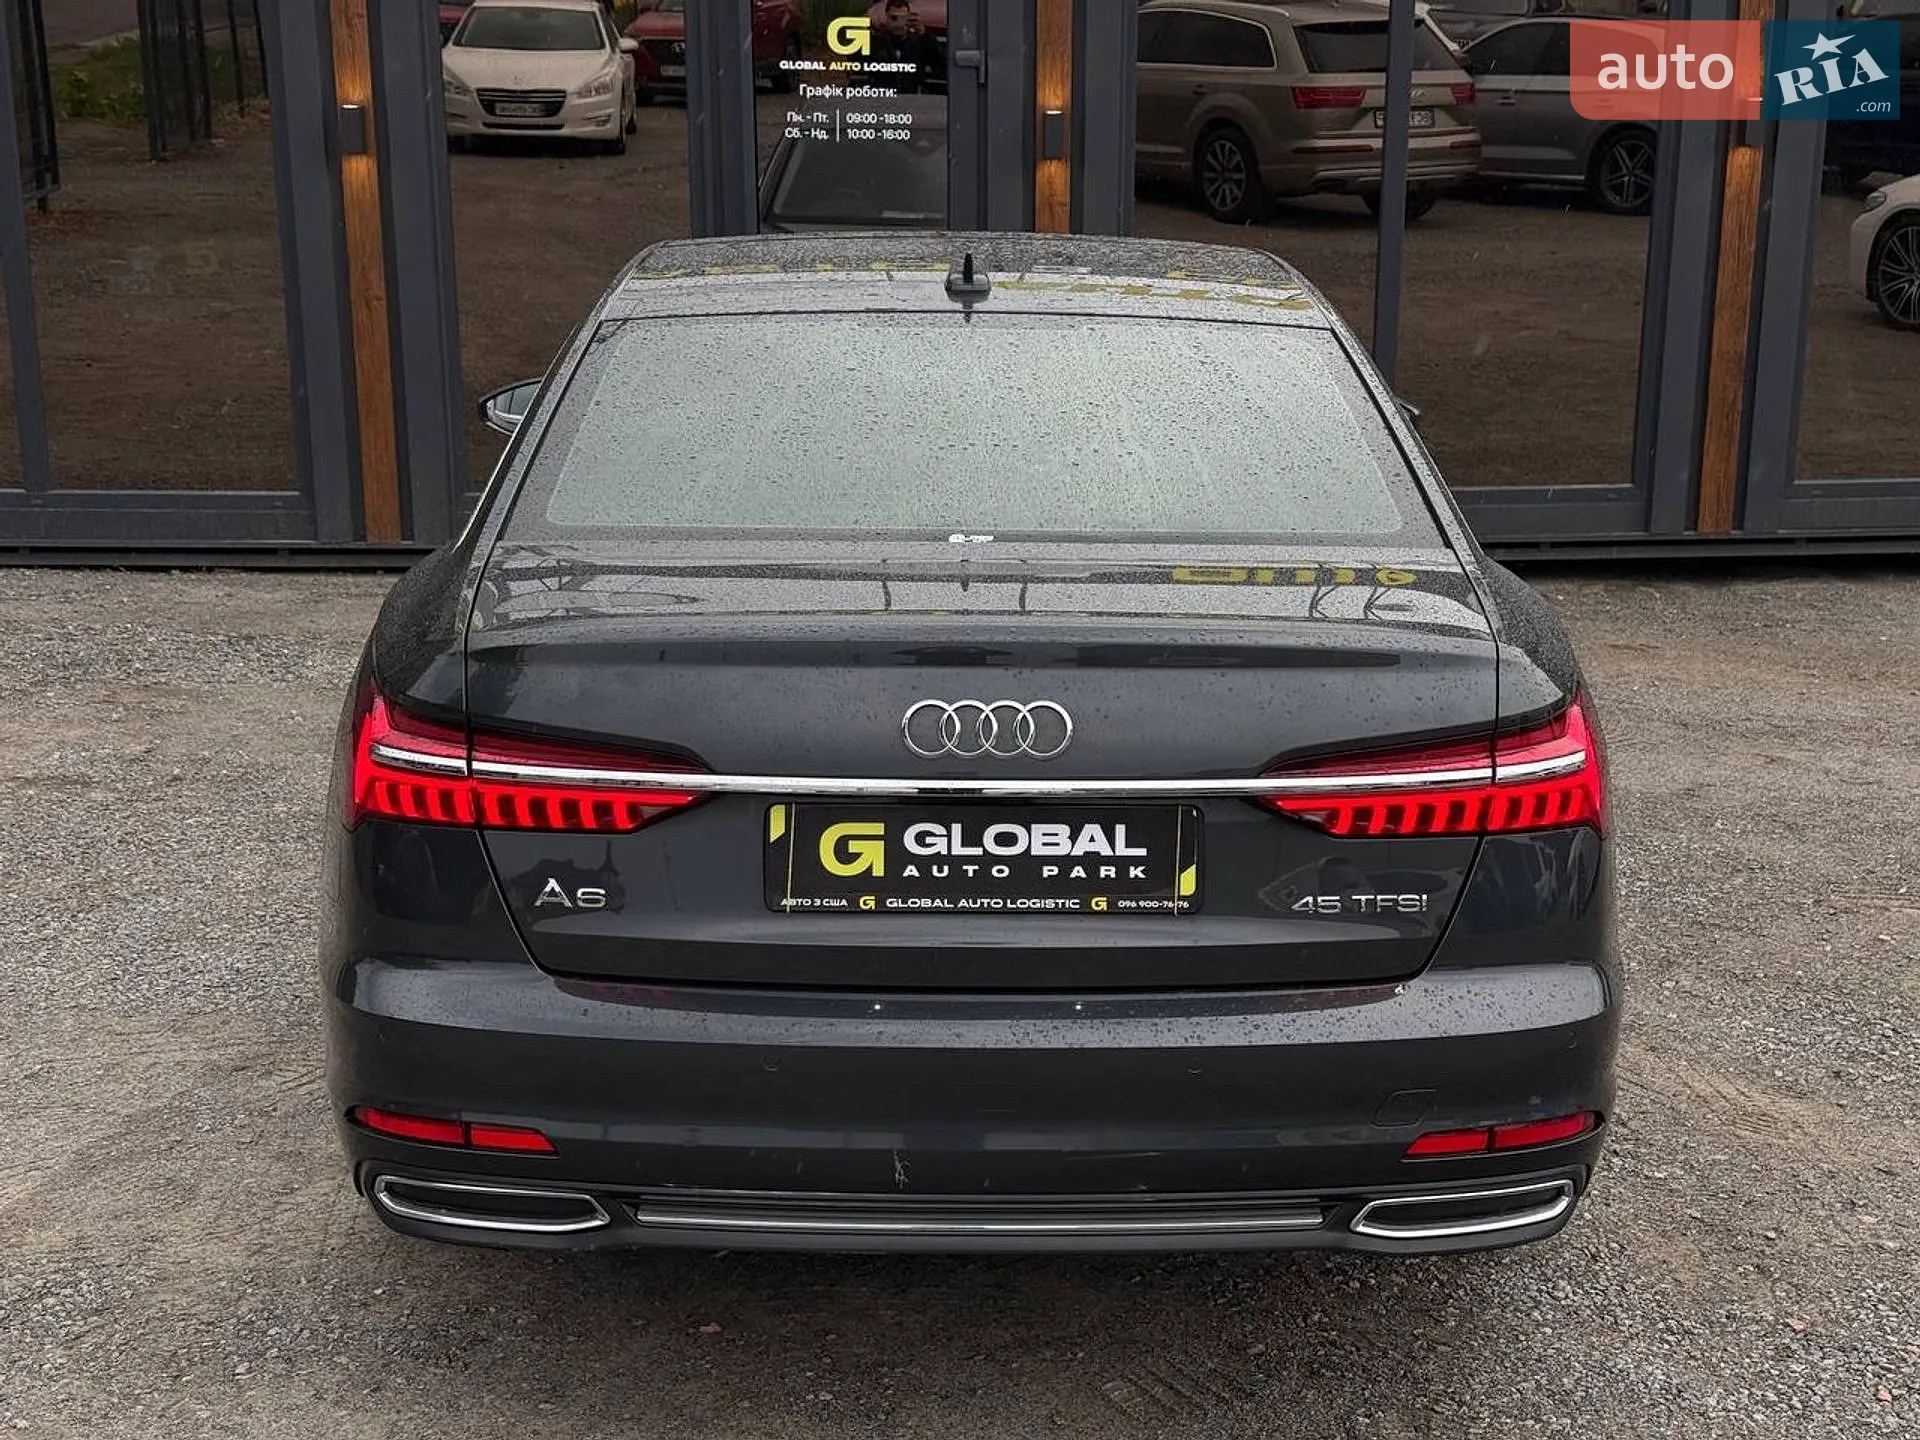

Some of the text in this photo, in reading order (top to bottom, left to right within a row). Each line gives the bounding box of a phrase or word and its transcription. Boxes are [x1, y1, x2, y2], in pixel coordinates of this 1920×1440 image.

[779, 60, 917, 73] GLOBAL AUTO LOGISTIC
[799, 83, 897, 99] Графік роботи:
[846, 112, 877, 124] 09:00
[903, 823, 1147, 856] GLOBAL
[902, 865, 1147, 878] AUTO PARK
[534, 877, 606, 907] A6
[886, 898, 1080, 909] GLOBAL AUTO LOGISTIC
[1291, 893, 1428, 914] 45 TFSI
